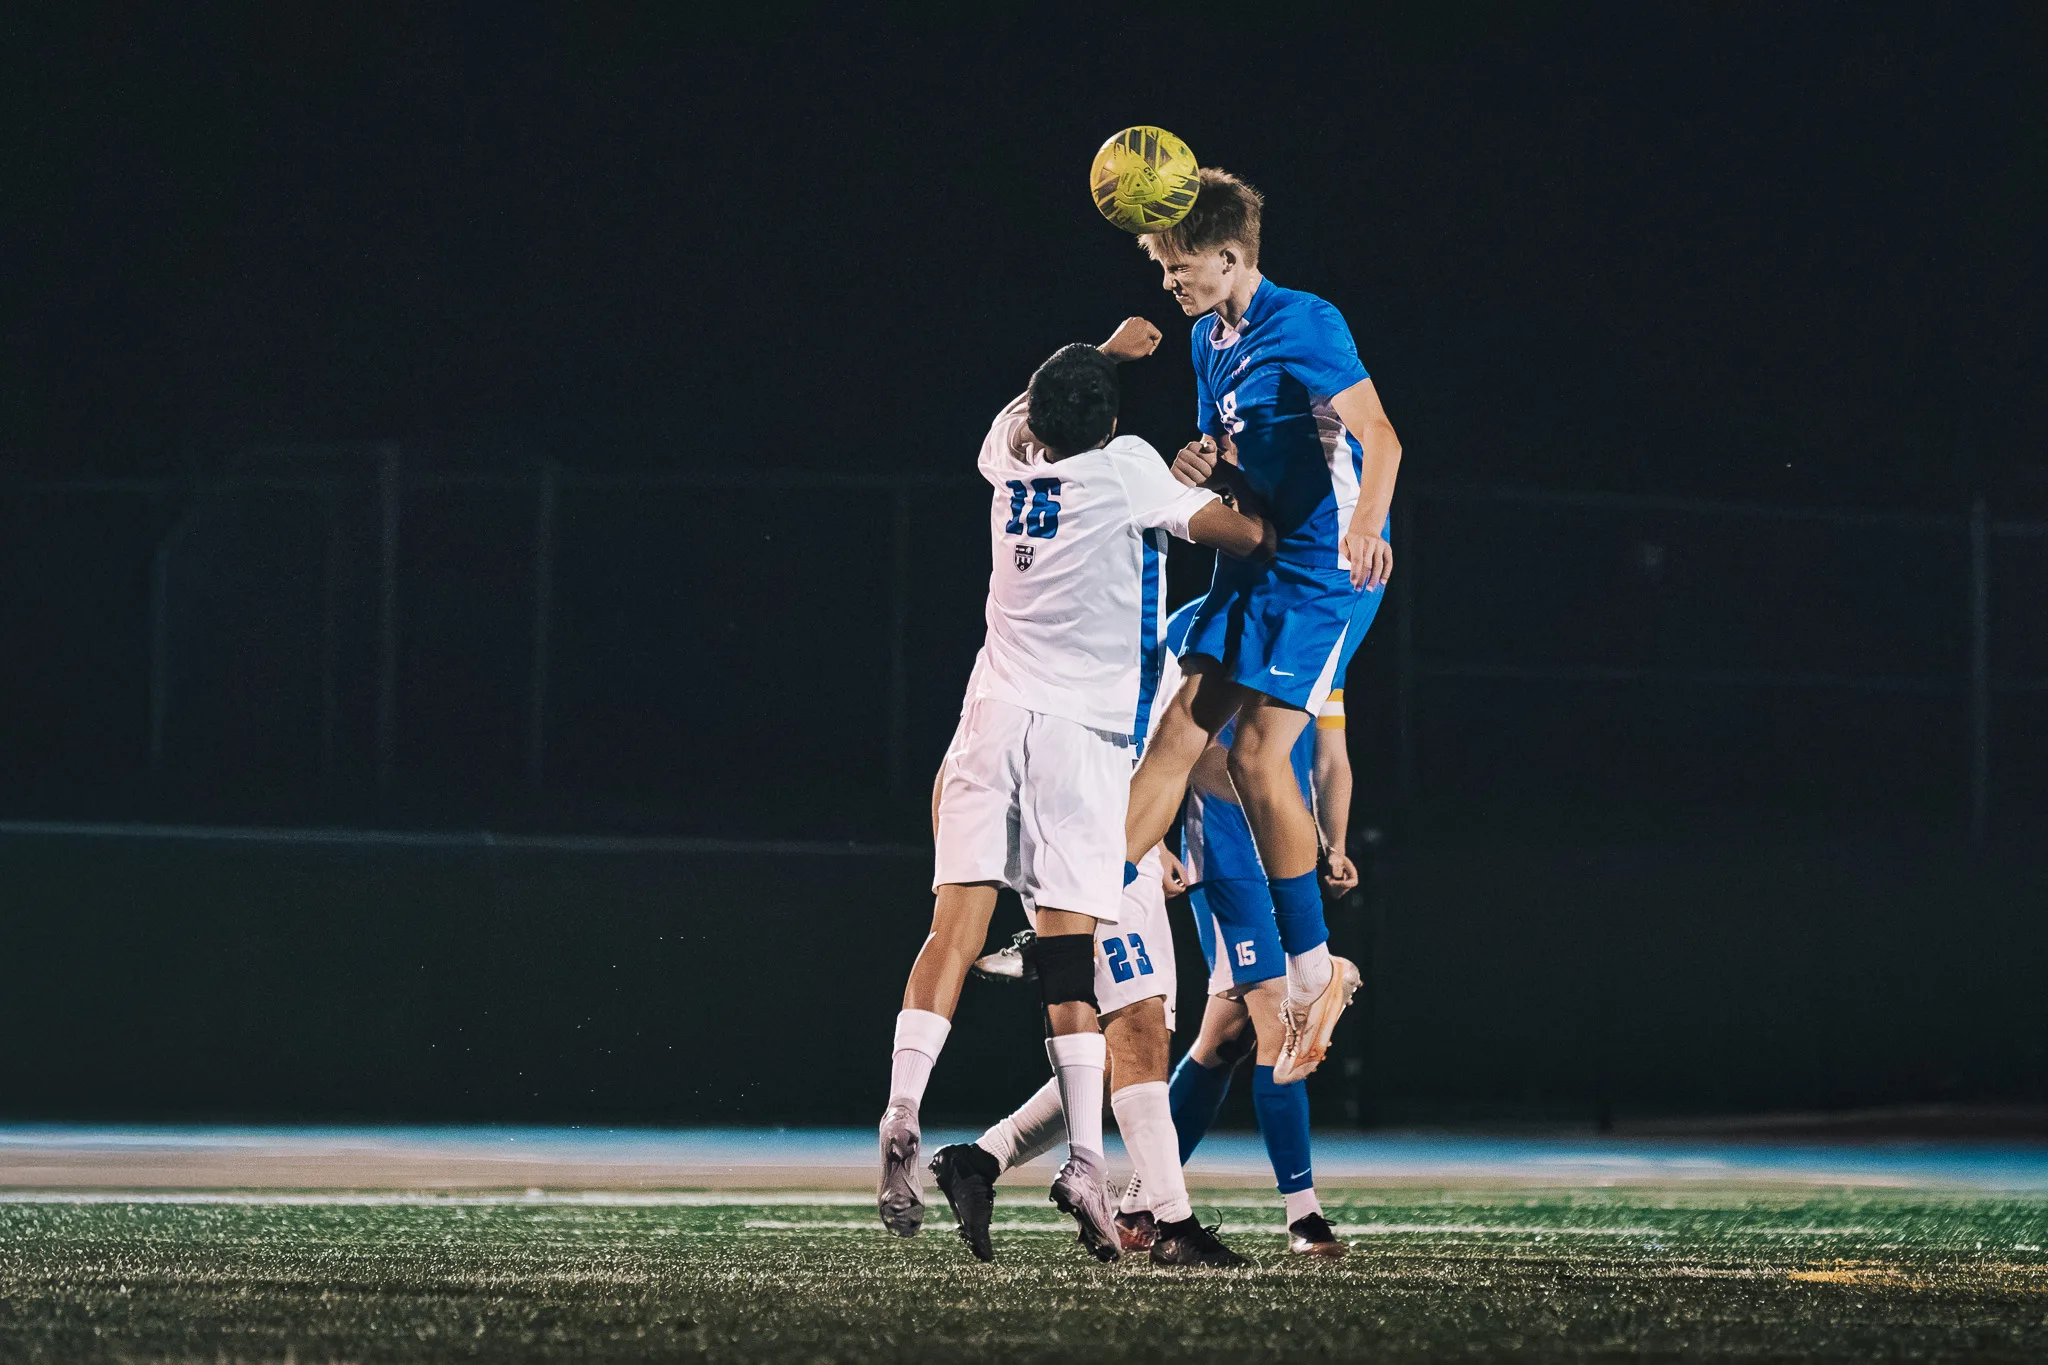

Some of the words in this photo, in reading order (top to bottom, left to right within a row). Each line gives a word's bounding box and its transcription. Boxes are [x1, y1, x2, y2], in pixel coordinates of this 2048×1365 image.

[1006, 477, 1061, 540] 16
[1102, 932, 1155, 984] 23
[1234, 940, 1257, 967] 15
